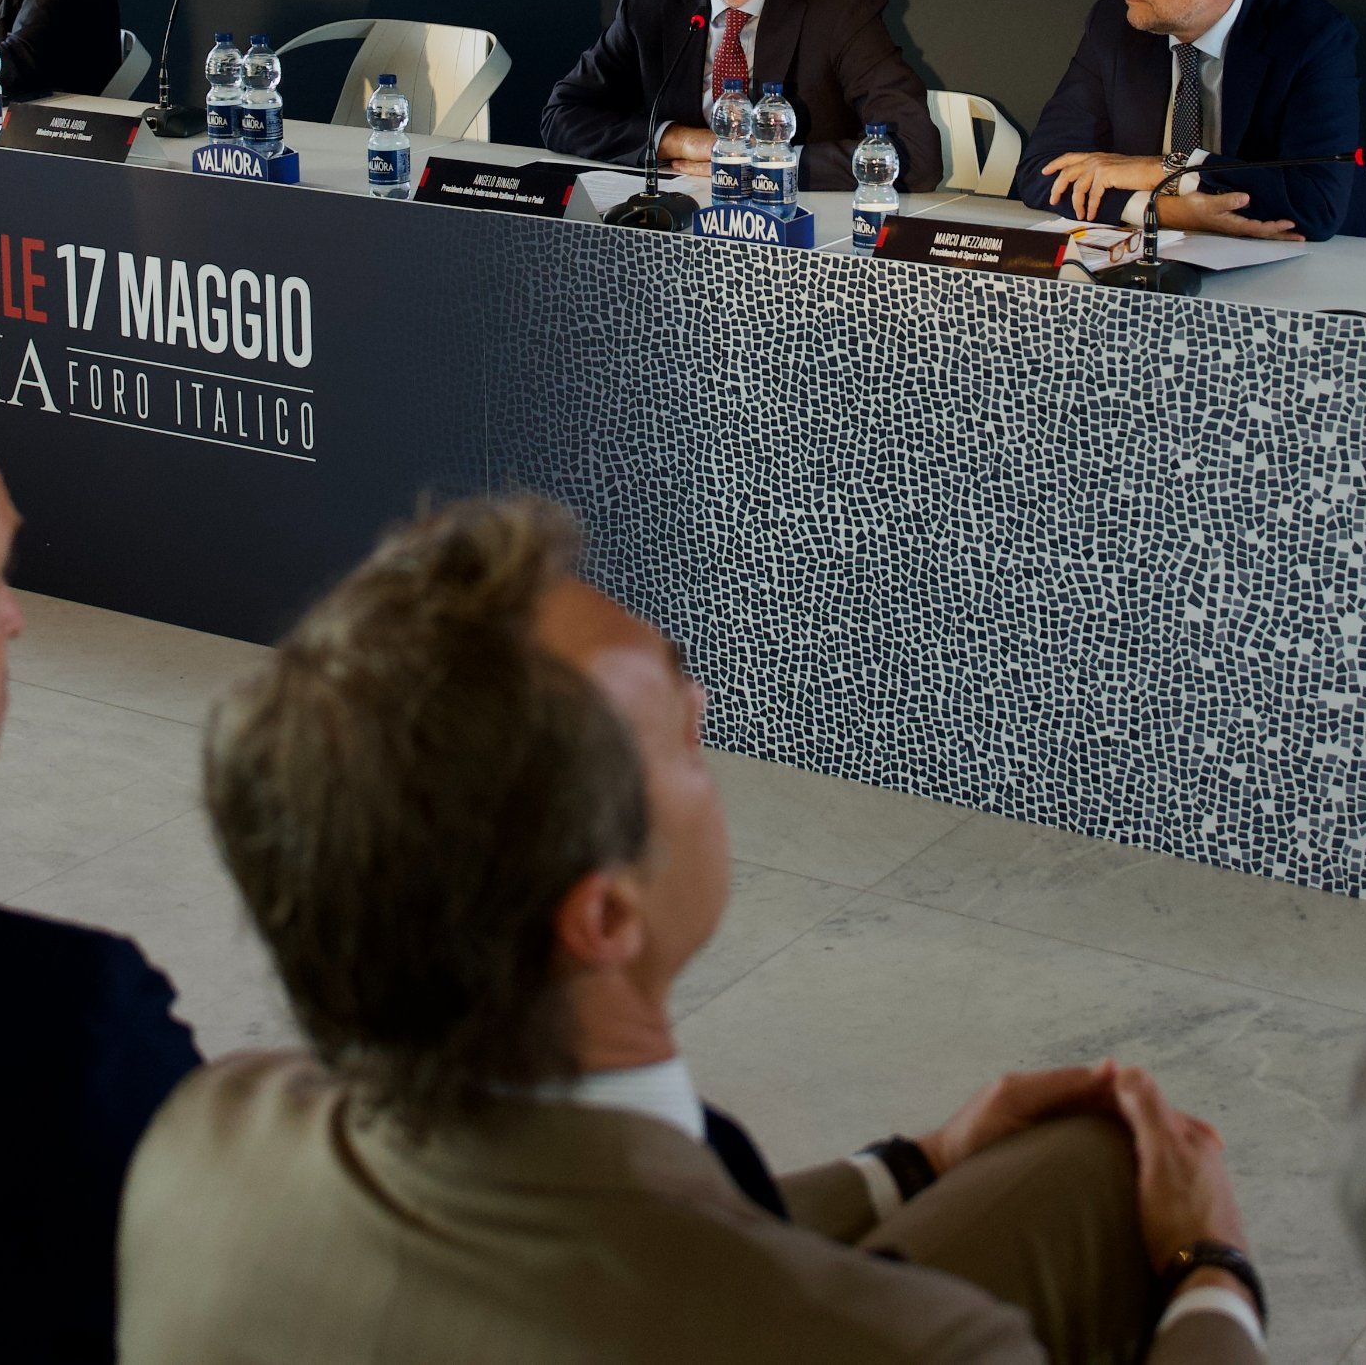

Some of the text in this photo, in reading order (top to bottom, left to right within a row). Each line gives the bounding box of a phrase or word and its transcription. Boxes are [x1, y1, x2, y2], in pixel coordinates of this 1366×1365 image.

[196, 148, 263, 178] VALMORA
[473, 174, 520, 190] ANGELO BINAGHI
[699, 209, 780, 243] VALMORA
[929, 247, 958, 258] Presidente
[963, 251, 978, 261] Sport
[934, 232, 1003, 251] MARCO MEZZAROMA
[56, 243, 107, 331] 17
[118, 250, 313, 369] MAGGIO
[68, 360, 150, 420] FORO
[175, 379, 315, 451] ITALICO
